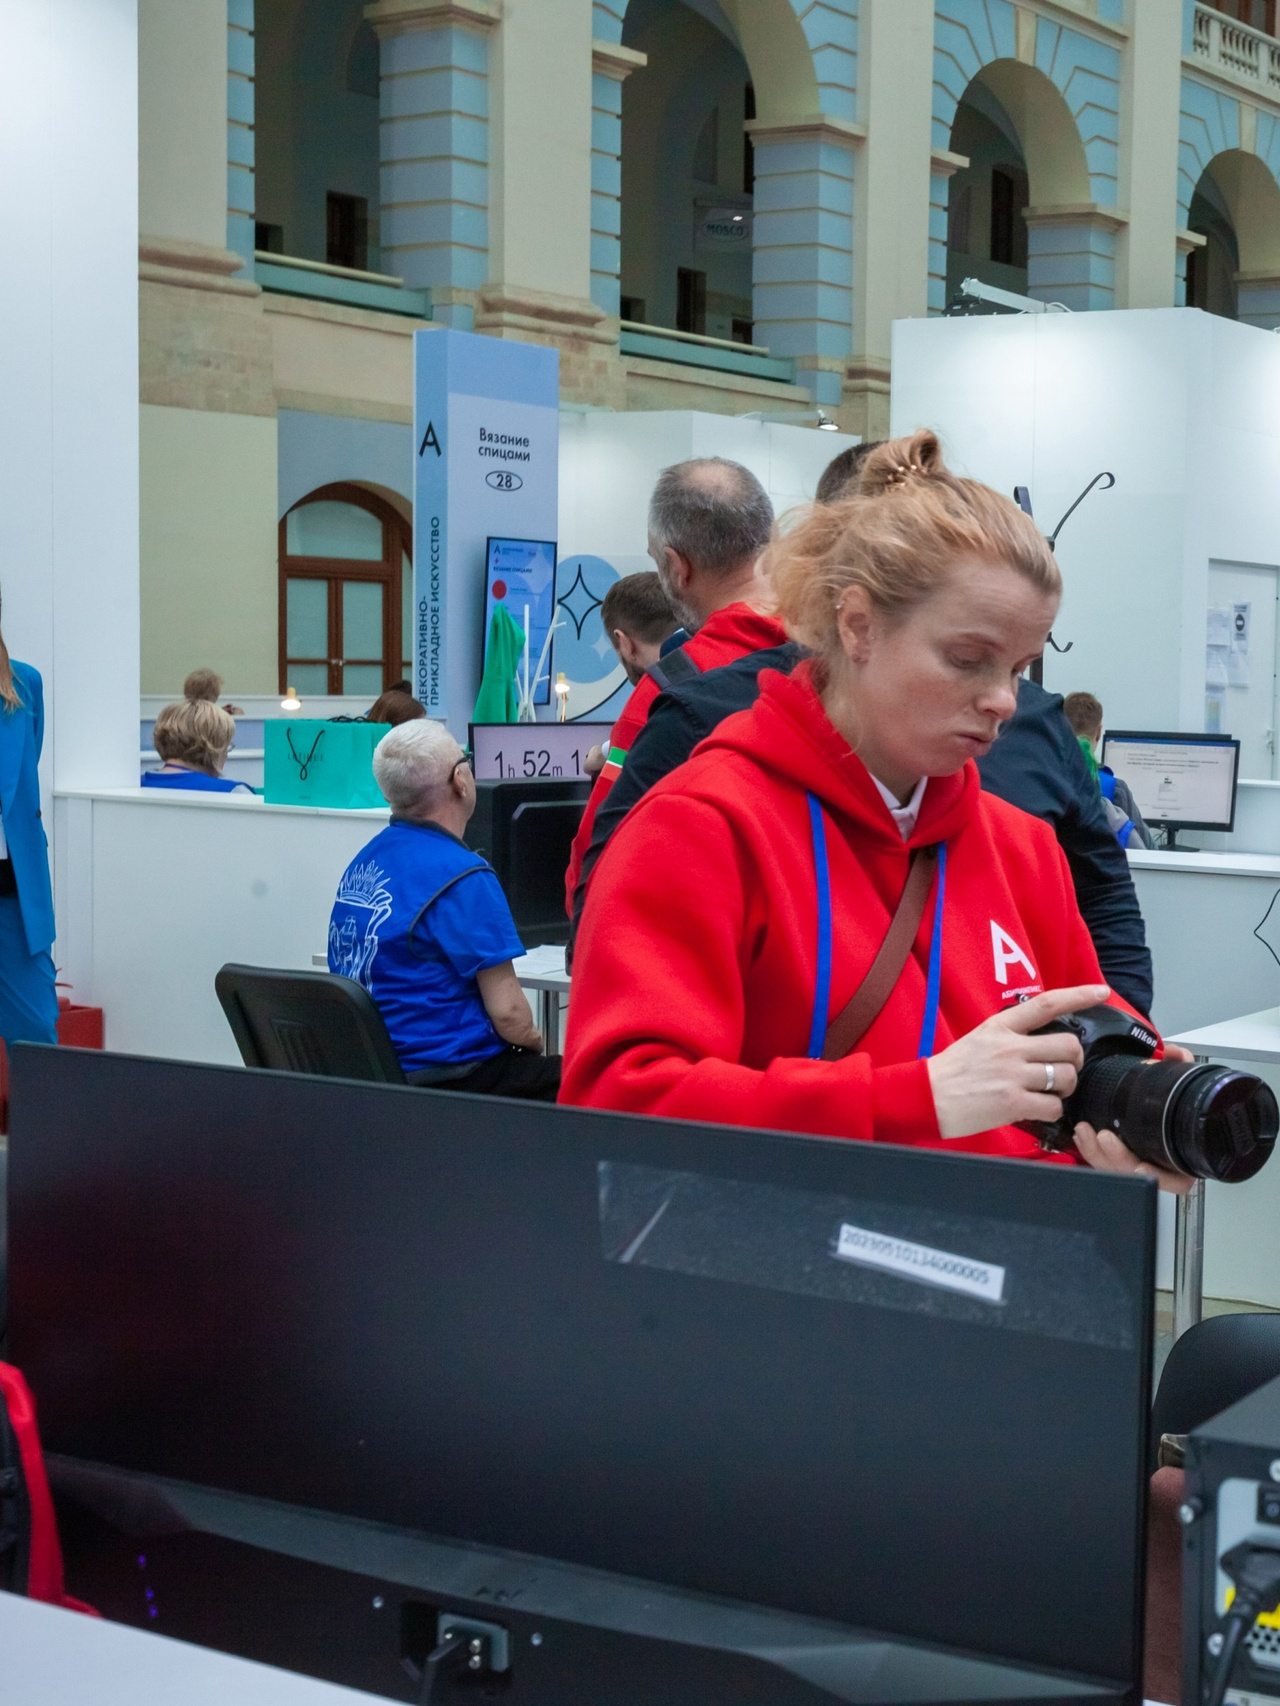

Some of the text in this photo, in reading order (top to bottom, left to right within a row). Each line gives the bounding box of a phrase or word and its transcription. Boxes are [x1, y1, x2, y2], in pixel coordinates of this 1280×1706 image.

[479, 427, 530, 447] Вязание
[478, 445, 531, 462] спицами
[496, 474, 513, 488] 28
[430, 516, 441, 706] ПРИКЛАДНОЕ ИСКУССТВО
[418, 596, 428, 706] ДЕКОРАТИВНО-
[1131, 1025, 1158, 1048] Nikon
